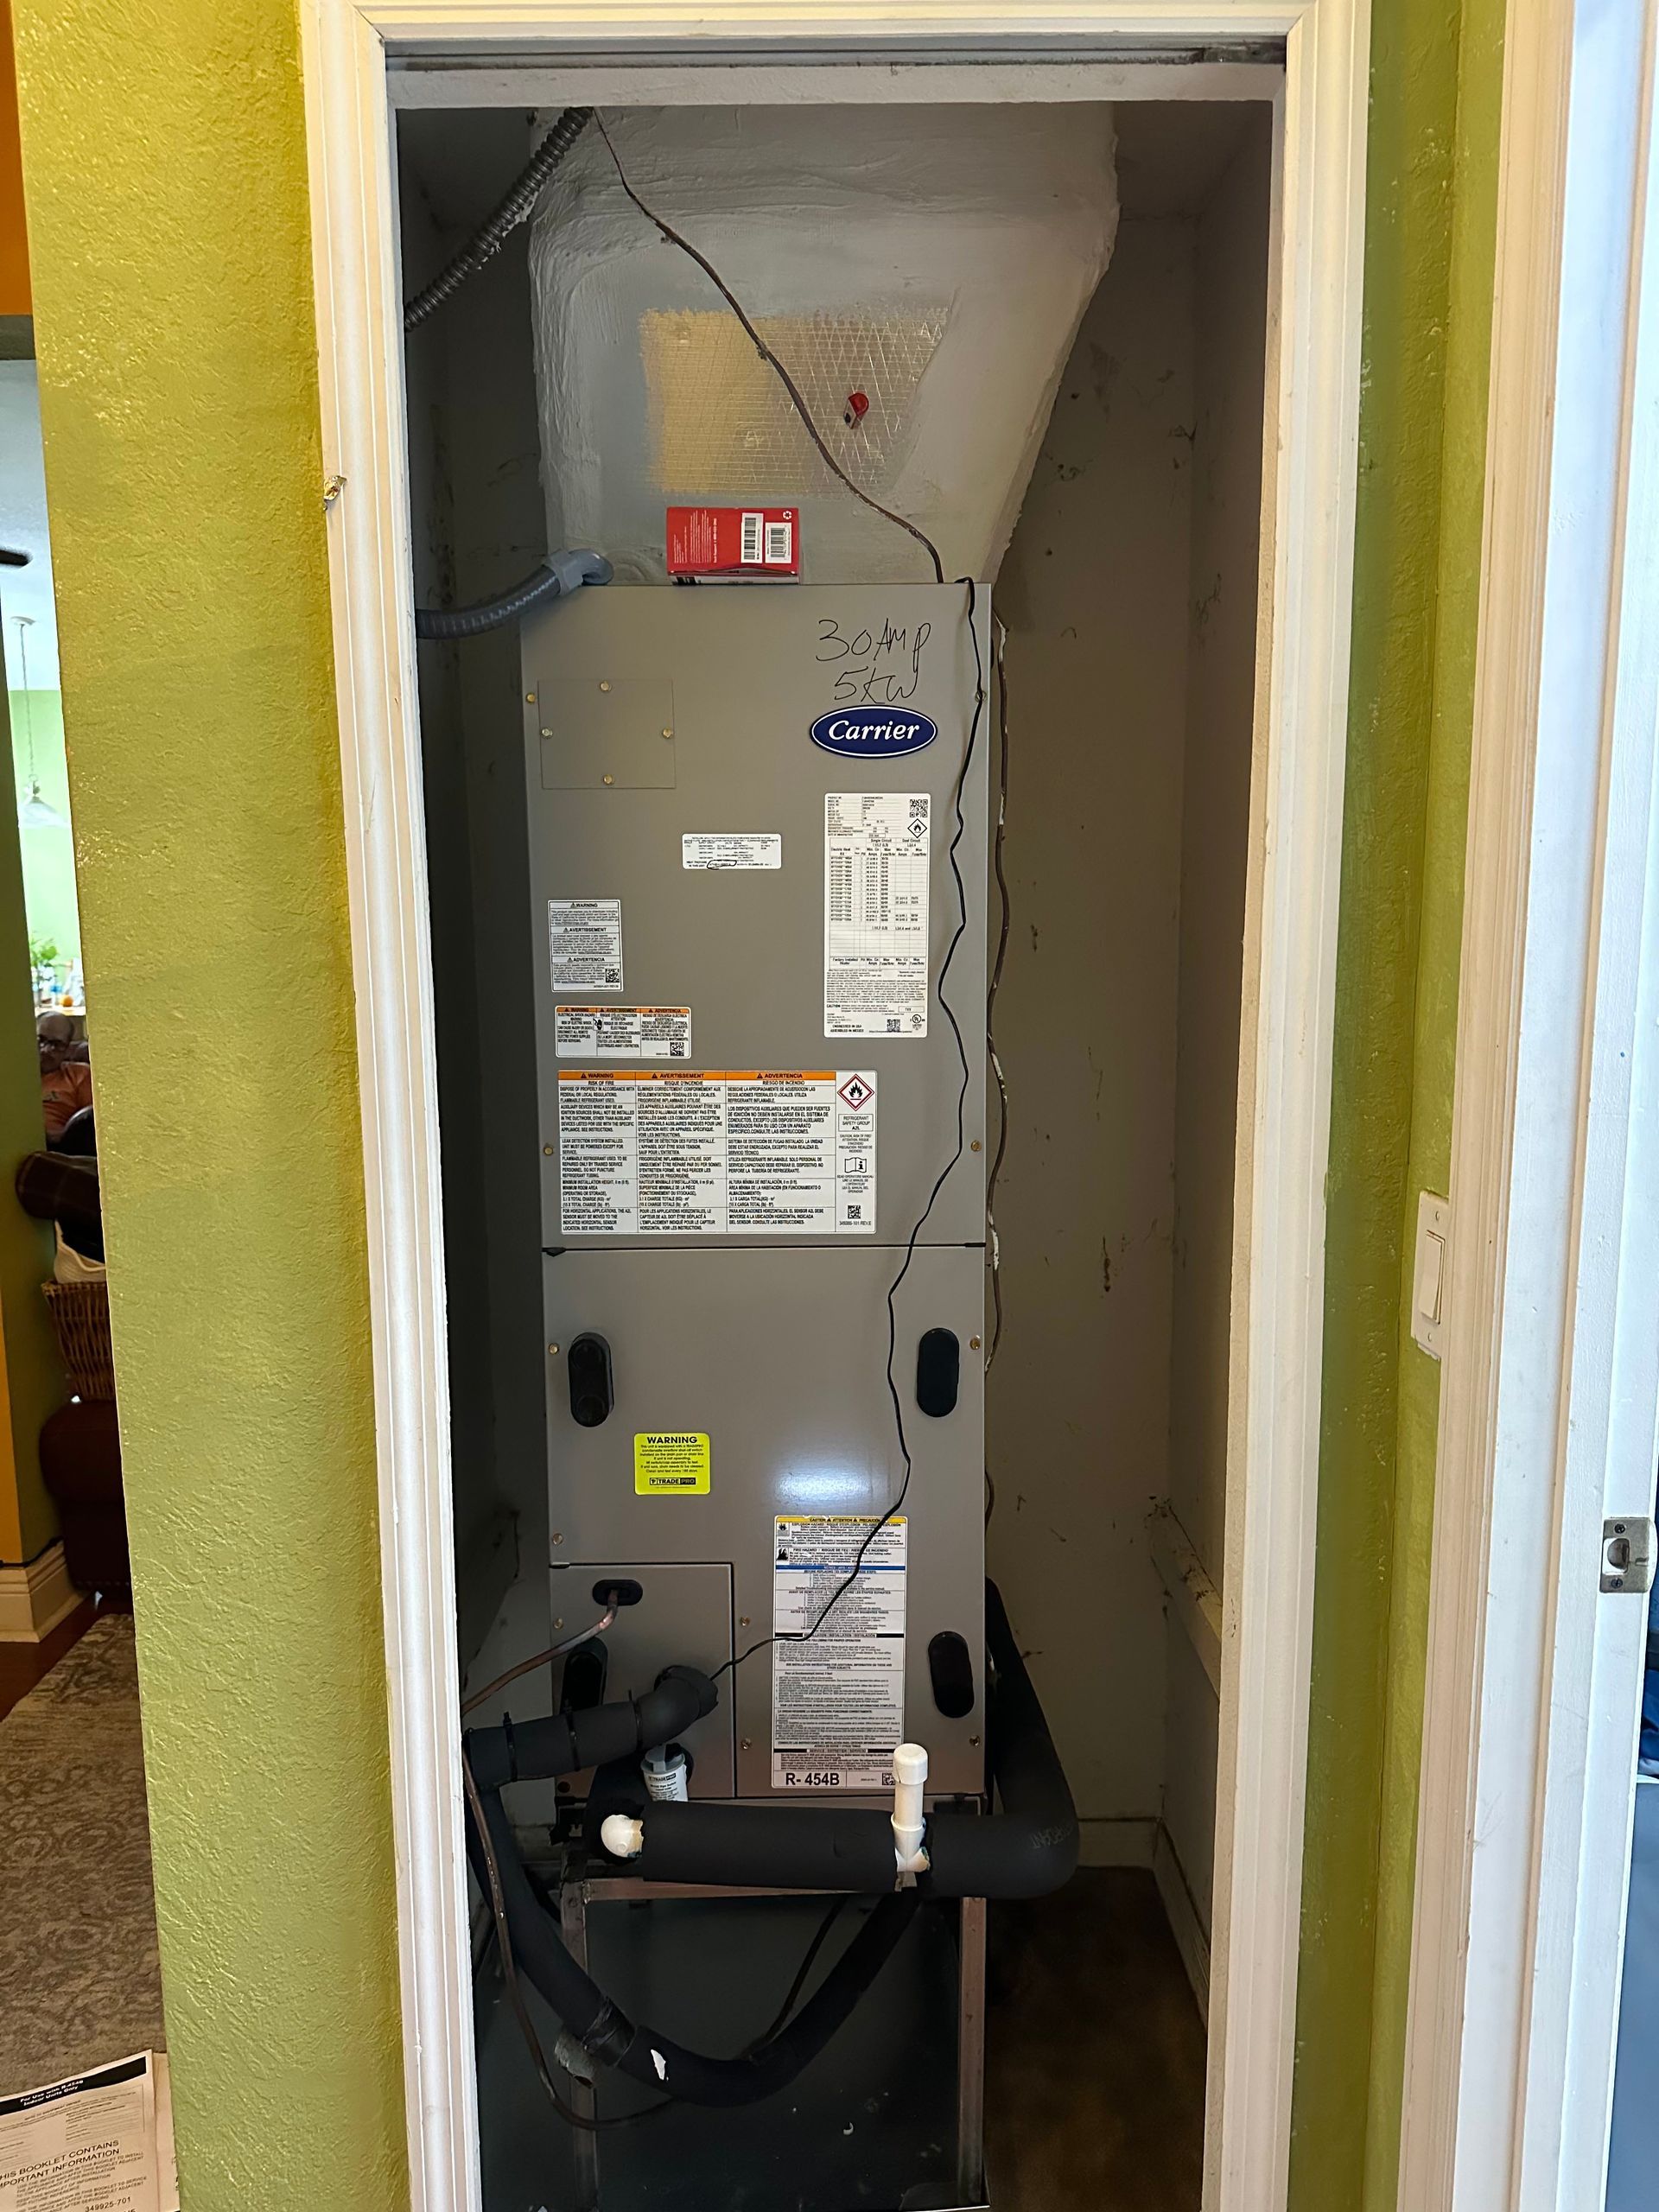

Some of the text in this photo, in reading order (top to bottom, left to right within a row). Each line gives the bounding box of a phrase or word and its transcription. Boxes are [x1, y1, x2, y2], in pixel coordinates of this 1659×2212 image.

[829, 720, 920, 741] Carrier
[786, 1773, 839, 1785] R- 454B
[24, 2097, 44, 2106] Indoor
[0, 2140, 119, 2179] HIS BOOKLET CONTAINS
[53, 2149, 119, 2173] INFORMATION
[86, 2197, 131, 2212] 349925-701
